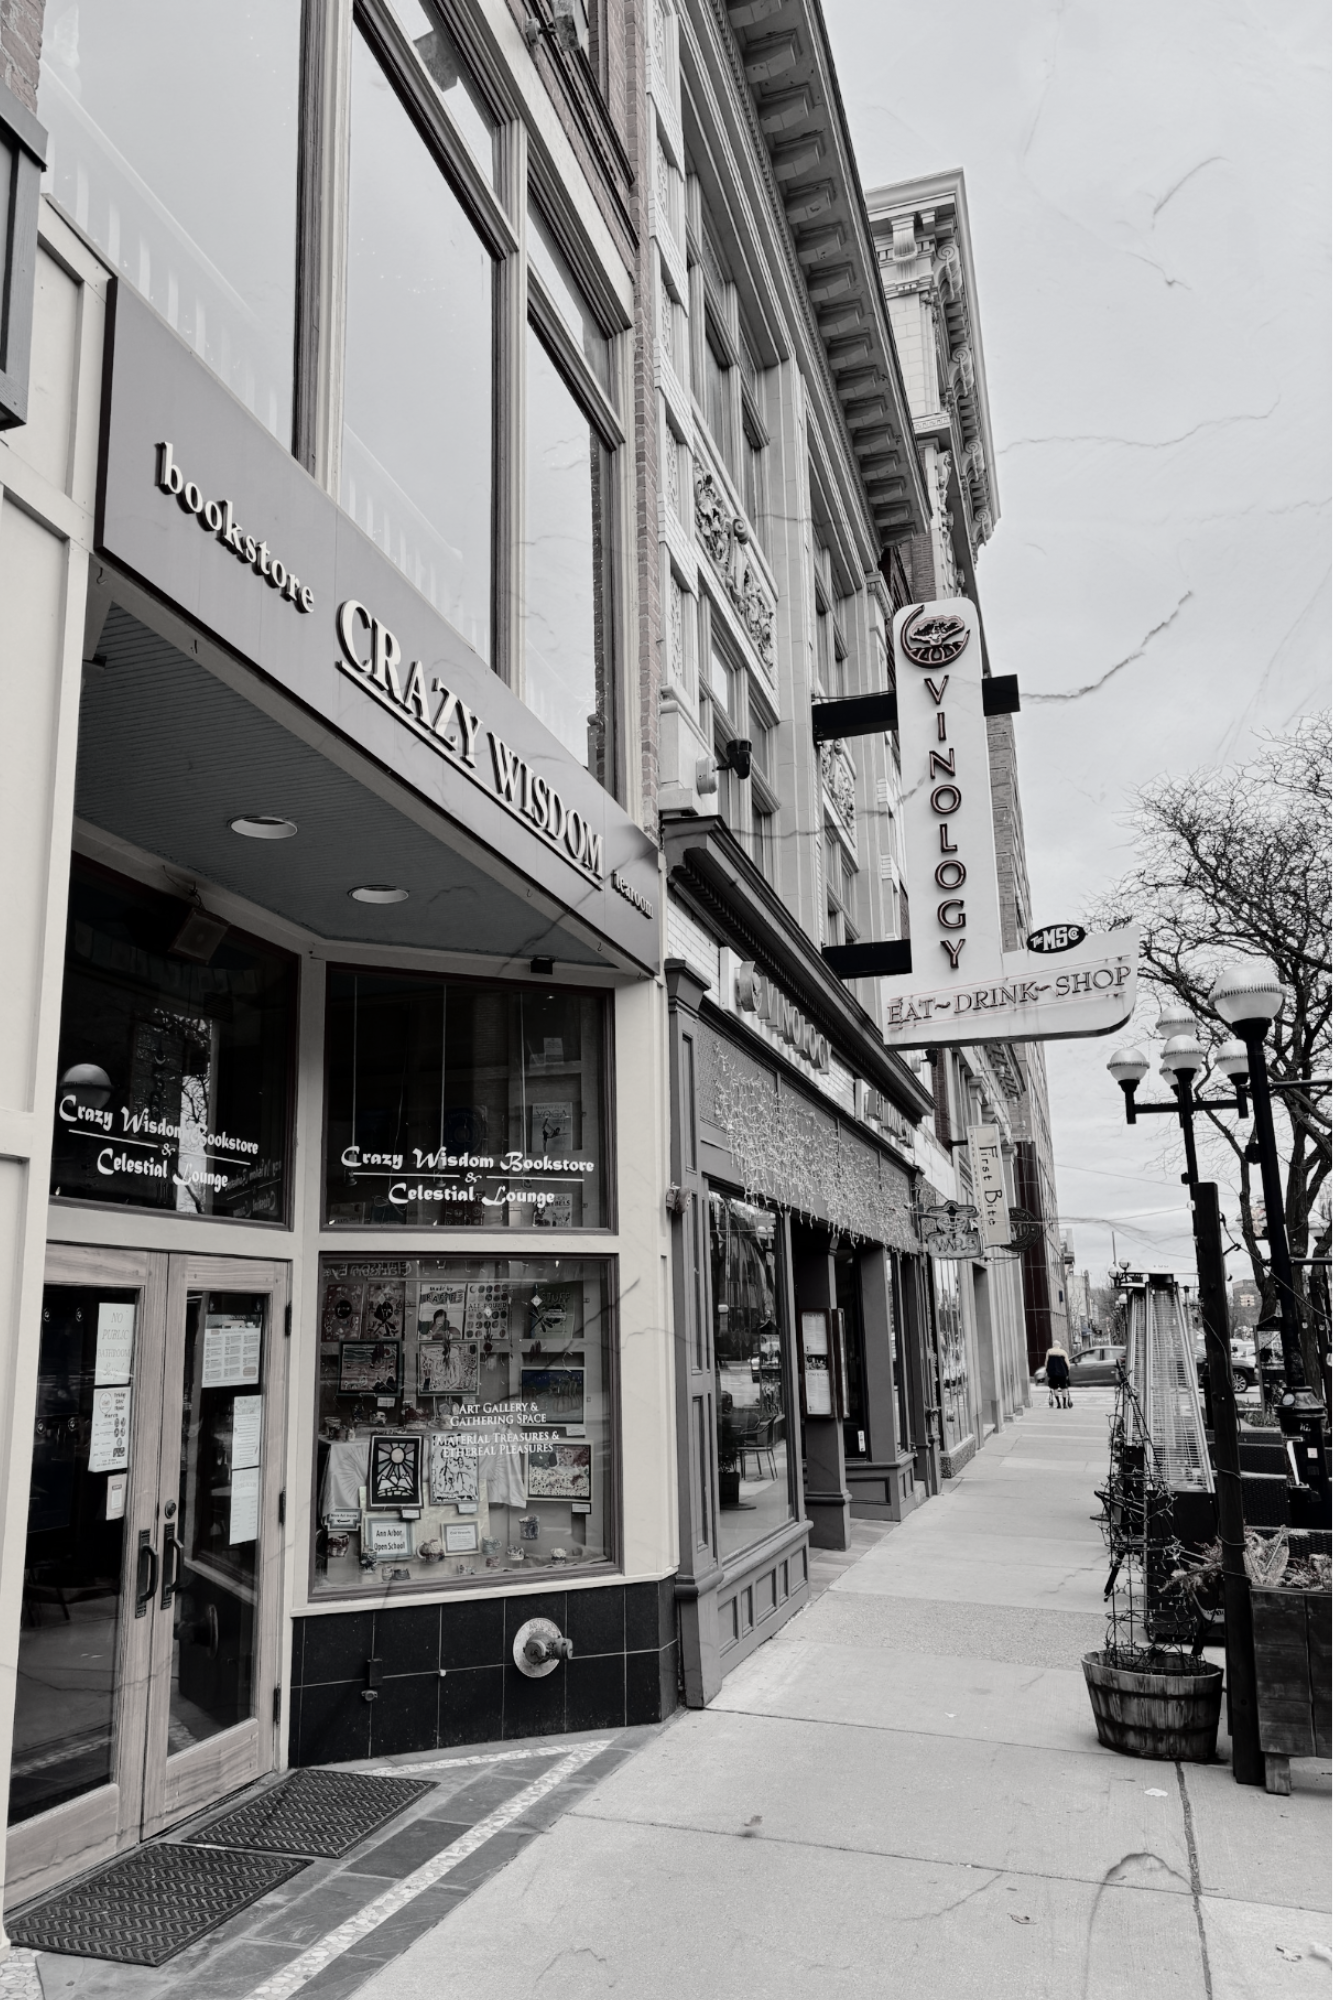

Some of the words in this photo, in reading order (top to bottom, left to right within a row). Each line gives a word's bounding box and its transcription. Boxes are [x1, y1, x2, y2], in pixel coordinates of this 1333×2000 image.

[155, 442, 315, 614] bookstore
[336, 599, 484, 770] CRAZY
[487, 731, 604, 880] WISDOM
[924, 675, 967, 969] VINOLOGY
[611, 869, 653, 919] tearoom
[59, 1094, 113, 1132] Crazy
[97, 1148, 168, 1179] Celestial
[172, 1163, 228, 1193] Lounge
[341, 1145, 404, 1170] Crazy
[412, 1146, 494, 1170] Wisdom
[500, 1152, 594, 1172] Bookstore
[979, 1145, 998, 1181] First
[388, 1183, 475, 1204] Celestial
[481, 1185, 555, 1209] Lounge
[984, 1189, 1003, 1226] Bite
[111, 1312, 123, 1323] NO
[102, 1329, 129, 1340] PUBLIC
[450, 1415, 514, 1427] GATHERING
[516, 1413, 546, 1424] SPACE
[459, 1404, 480, 1415] ART
[483, 1402, 528, 1414] GALLERY
[492, 1431, 549, 1443] TREASURES
[499, 1443, 554, 1456] PLEASURES
[376, 1529, 386, 1537] Ann
[387, 1528, 402, 1537] Arbor
[374, 1542, 387, 1552] Open
[387, 1541, 405, 1550] School
